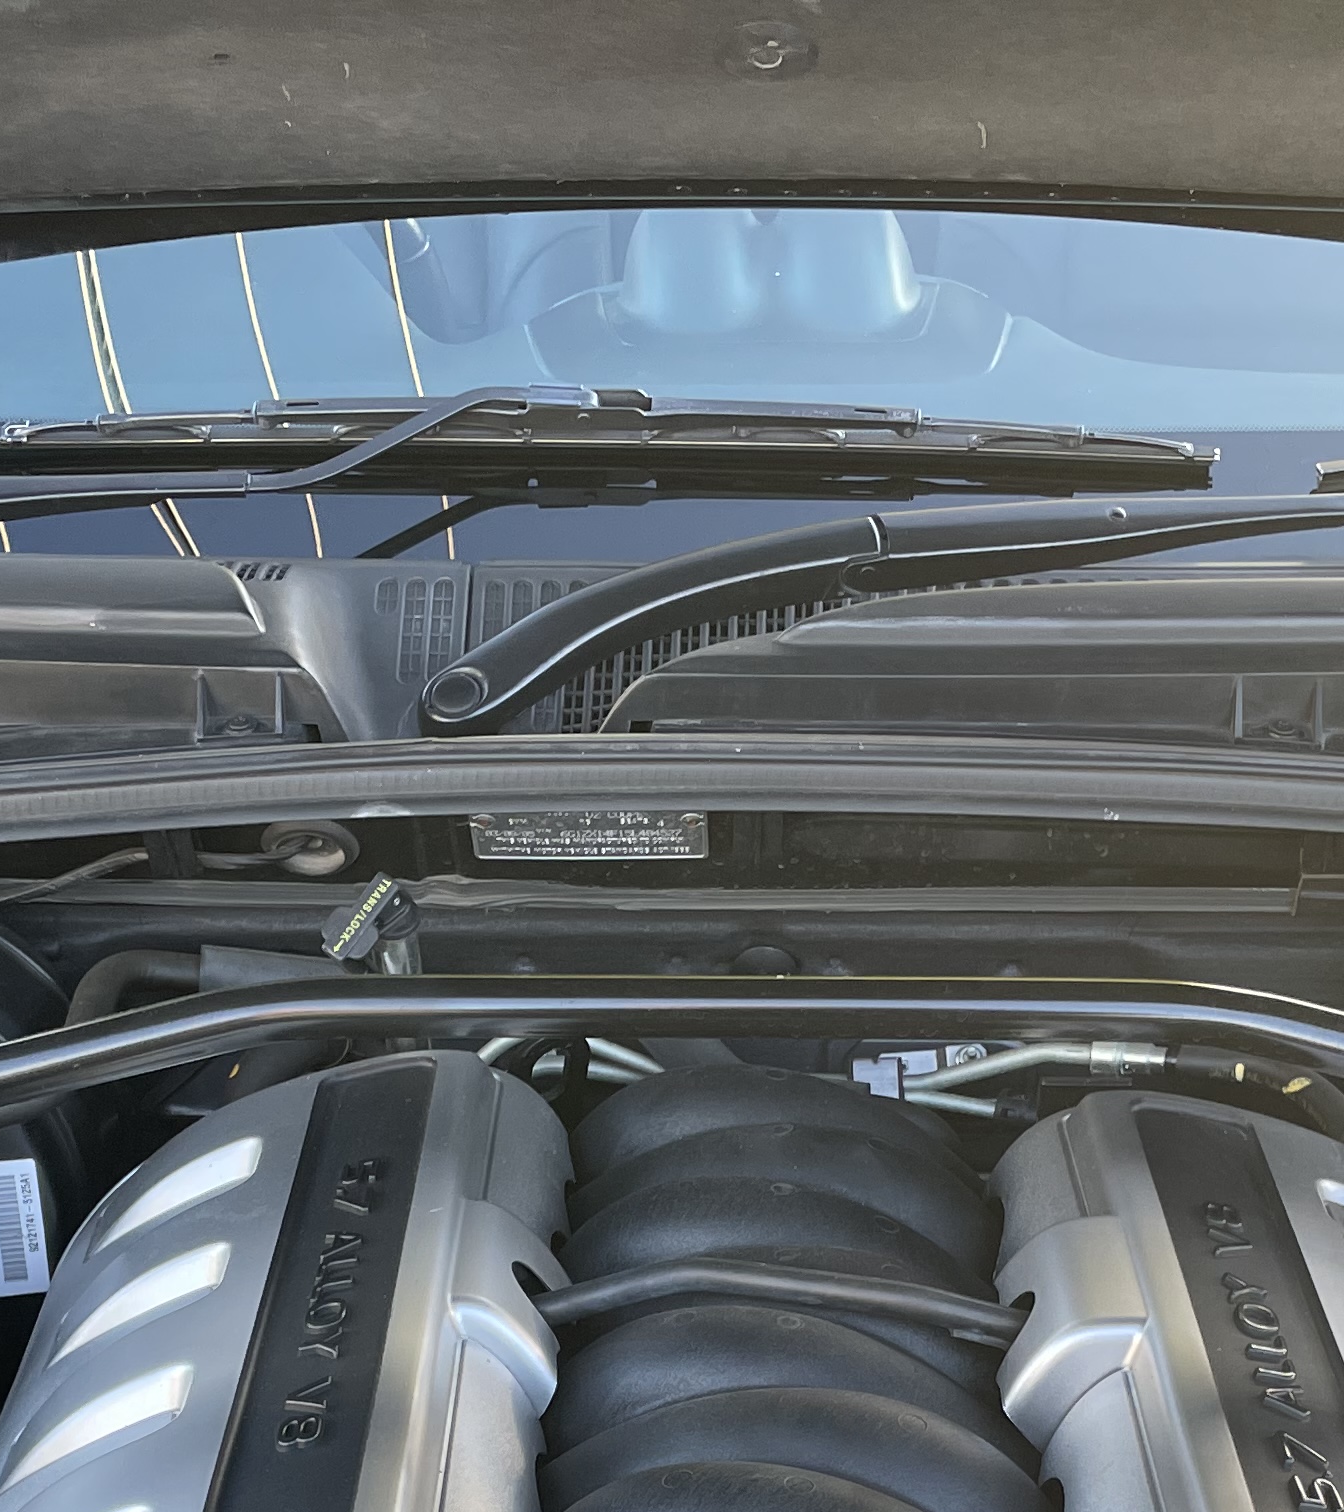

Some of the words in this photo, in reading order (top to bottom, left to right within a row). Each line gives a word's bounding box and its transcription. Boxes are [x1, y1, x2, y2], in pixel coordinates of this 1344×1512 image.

[339, 879, 392, 944] TRANS/LOCK
[1204, 1202, 1254, 1257] V8
[298, 1232, 362, 1359] ALLOY
[1221, 1272, 1311, 1420] ALLOY
[276, 1376, 333, 1452] V8
